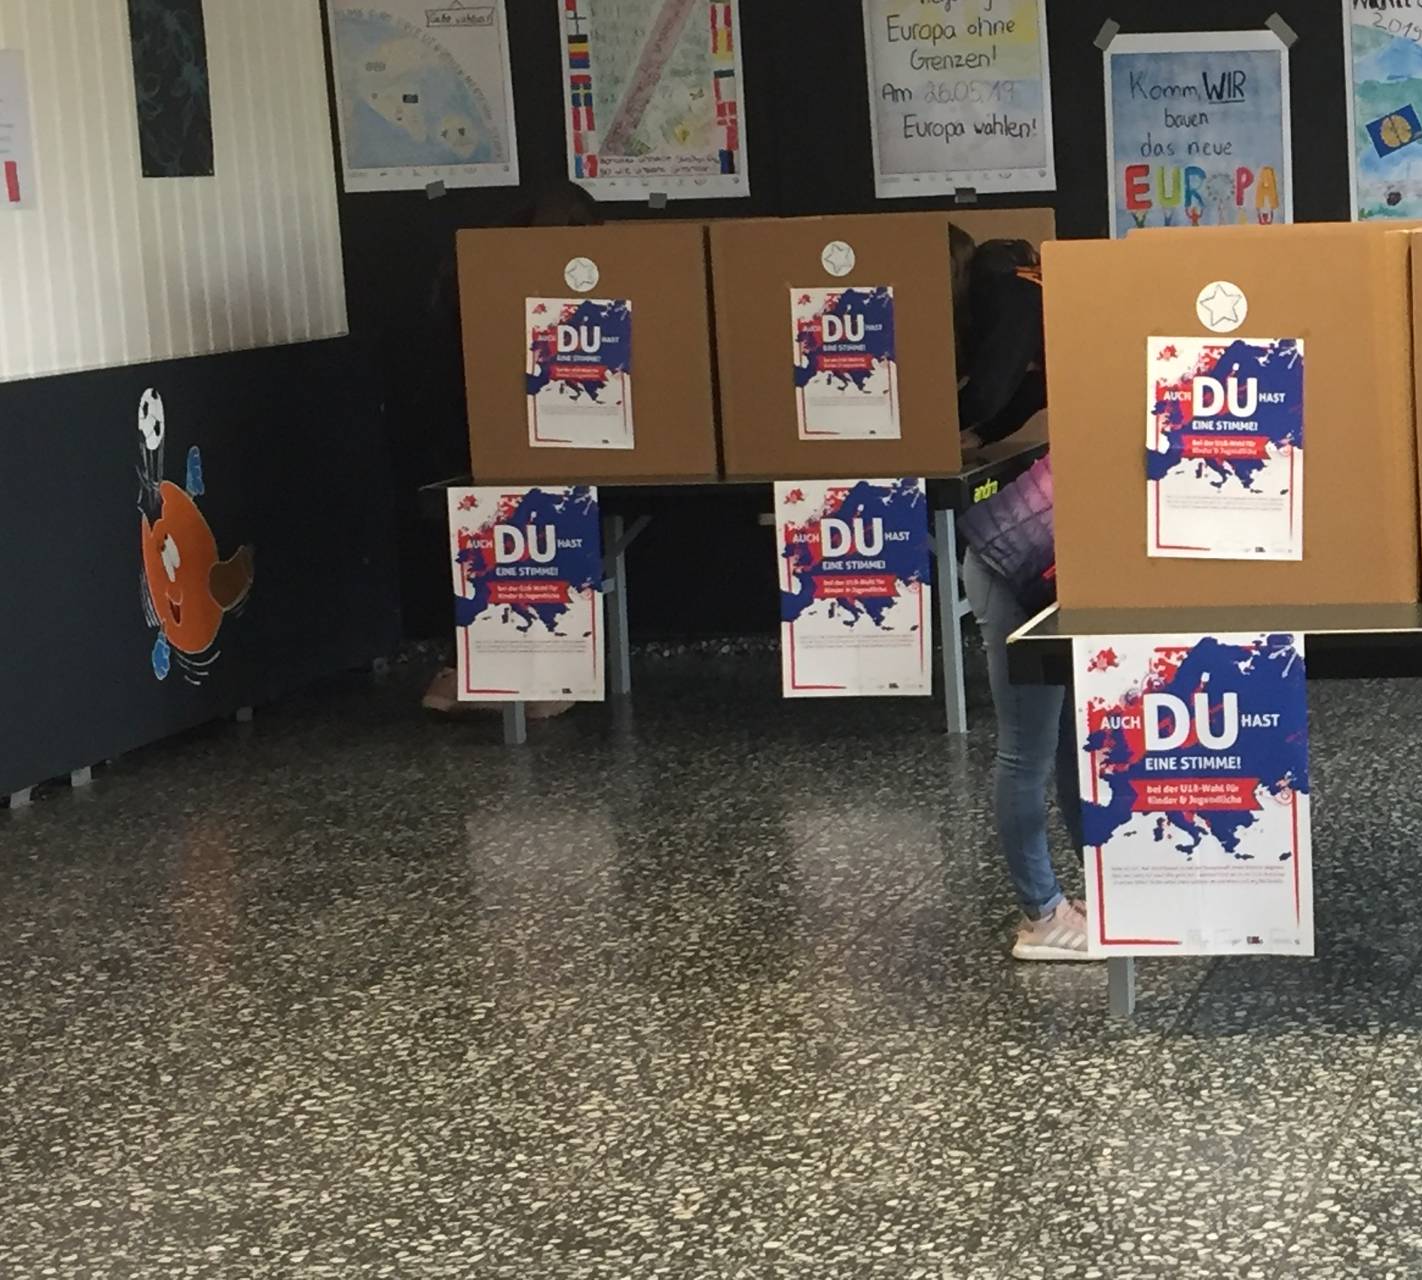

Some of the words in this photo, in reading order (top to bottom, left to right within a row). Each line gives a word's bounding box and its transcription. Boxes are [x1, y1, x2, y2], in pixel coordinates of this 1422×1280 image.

[886, 14, 956, 46] Europa
[967, 17, 1016, 37] ohne
[910, 45, 997, 71] Grenzen!
[882, 83, 913, 101] Am
[1202, 70, 1246, 102] WIR
[903, 114, 965, 144] Europa
[974, 112, 1037, 139] wählen!
[1164, 108, 1209, 128] bauen
[1140, 132, 1176, 157] das
[1188, 142, 1233, 156] neue
[557, 325, 600, 353] DU
[822, 314, 864, 343] DU
[1163, 391, 1191, 401] AUCH
[1192, 376, 1258, 418] DU
[1259, 392, 1286, 404] HAST
[1192, 420, 1214, 431] EINE
[1216, 420, 1258, 431] STIMME!
[466, 539, 493, 549] AUCH
[494, 524, 556, 564] DU
[558, 538, 583, 549] HAST
[792, 533, 819, 543] AUCH
[820, 517, 884, 558] DU
[884, 531, 911, 541] HAST
[496, 567, 518, 576] EINE
[822, 561, 844, 571] EINE
[1100, 716, 1141, 730] AUCH
[1143, 692, 1238, 751] DU
[1241, 713, 1280, 729] HAST
[1145, 757, 1177, 771] EINE
[1180, 755, 1242, 770] STIMME!
[1146, 784, 1161, 793] bei
[1163, 784, 1178, 793] der
